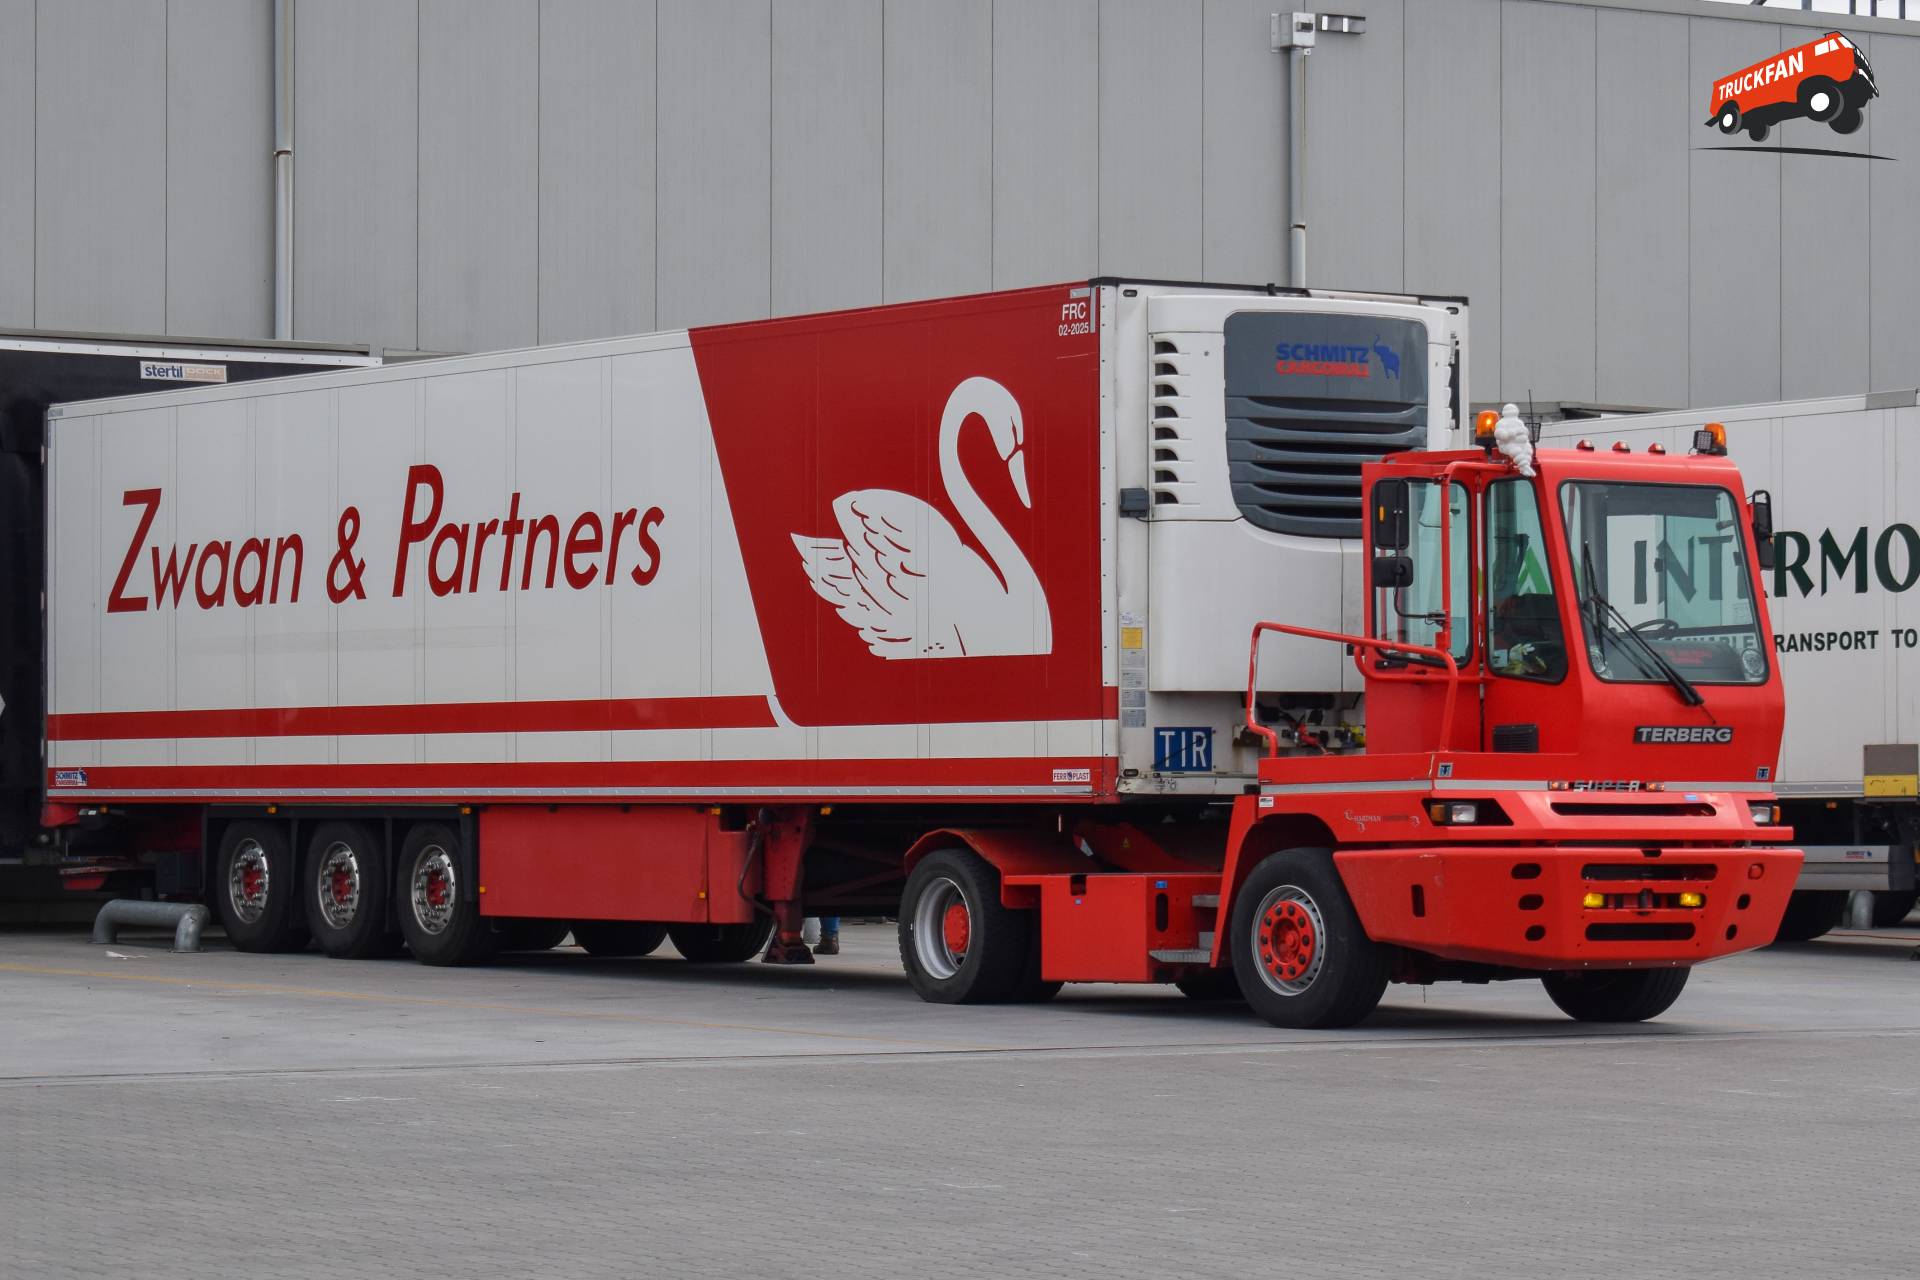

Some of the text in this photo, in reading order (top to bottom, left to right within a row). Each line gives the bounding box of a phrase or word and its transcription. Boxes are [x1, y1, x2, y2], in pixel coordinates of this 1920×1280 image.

[1062, 302, 1087, 320] FRC
[1058, 322, 1089, 336] 02-2025
[1275, 343, 1370, 363] SCHMITZ
[145, 365, 184, 378] stertil
[107, 464, 665, 614] Zwaan & Partners
[1891, 628, 1918, 649] TO
[1638, 727, 1732, 742] TERBERG
[1159, 731, 1207, 768] TIR
